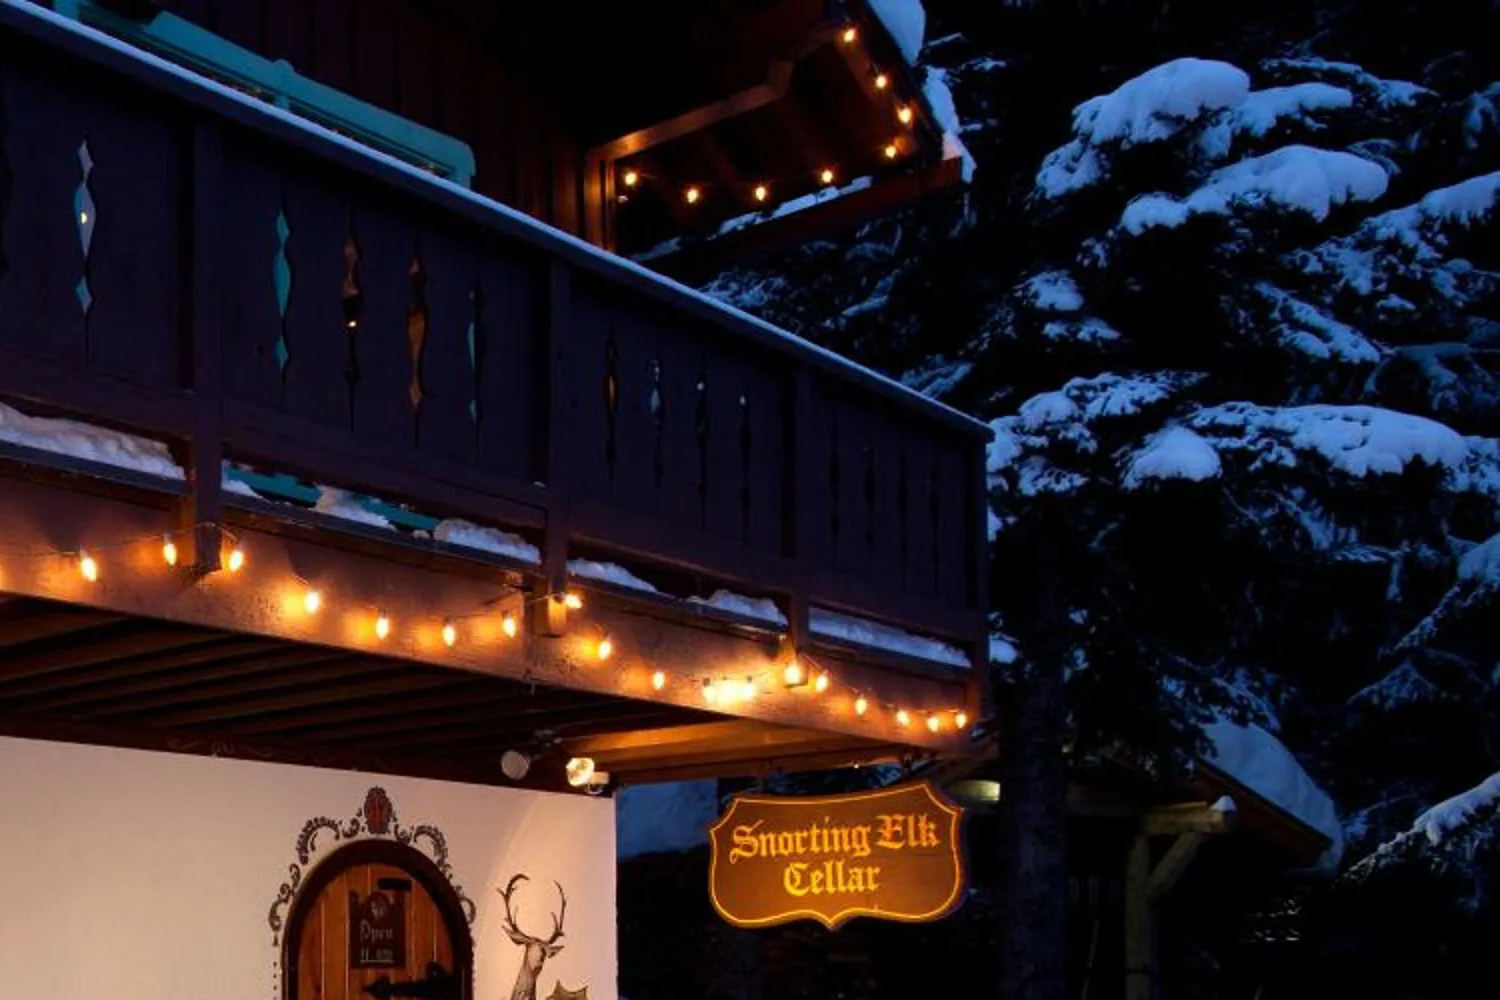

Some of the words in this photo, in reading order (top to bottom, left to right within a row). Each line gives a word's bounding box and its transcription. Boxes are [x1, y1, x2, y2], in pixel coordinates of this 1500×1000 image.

[730, 817, 871, 864] Snorting
[876, 814, 940, 849] Elk
[784, 860, 880, 896] Cellar
